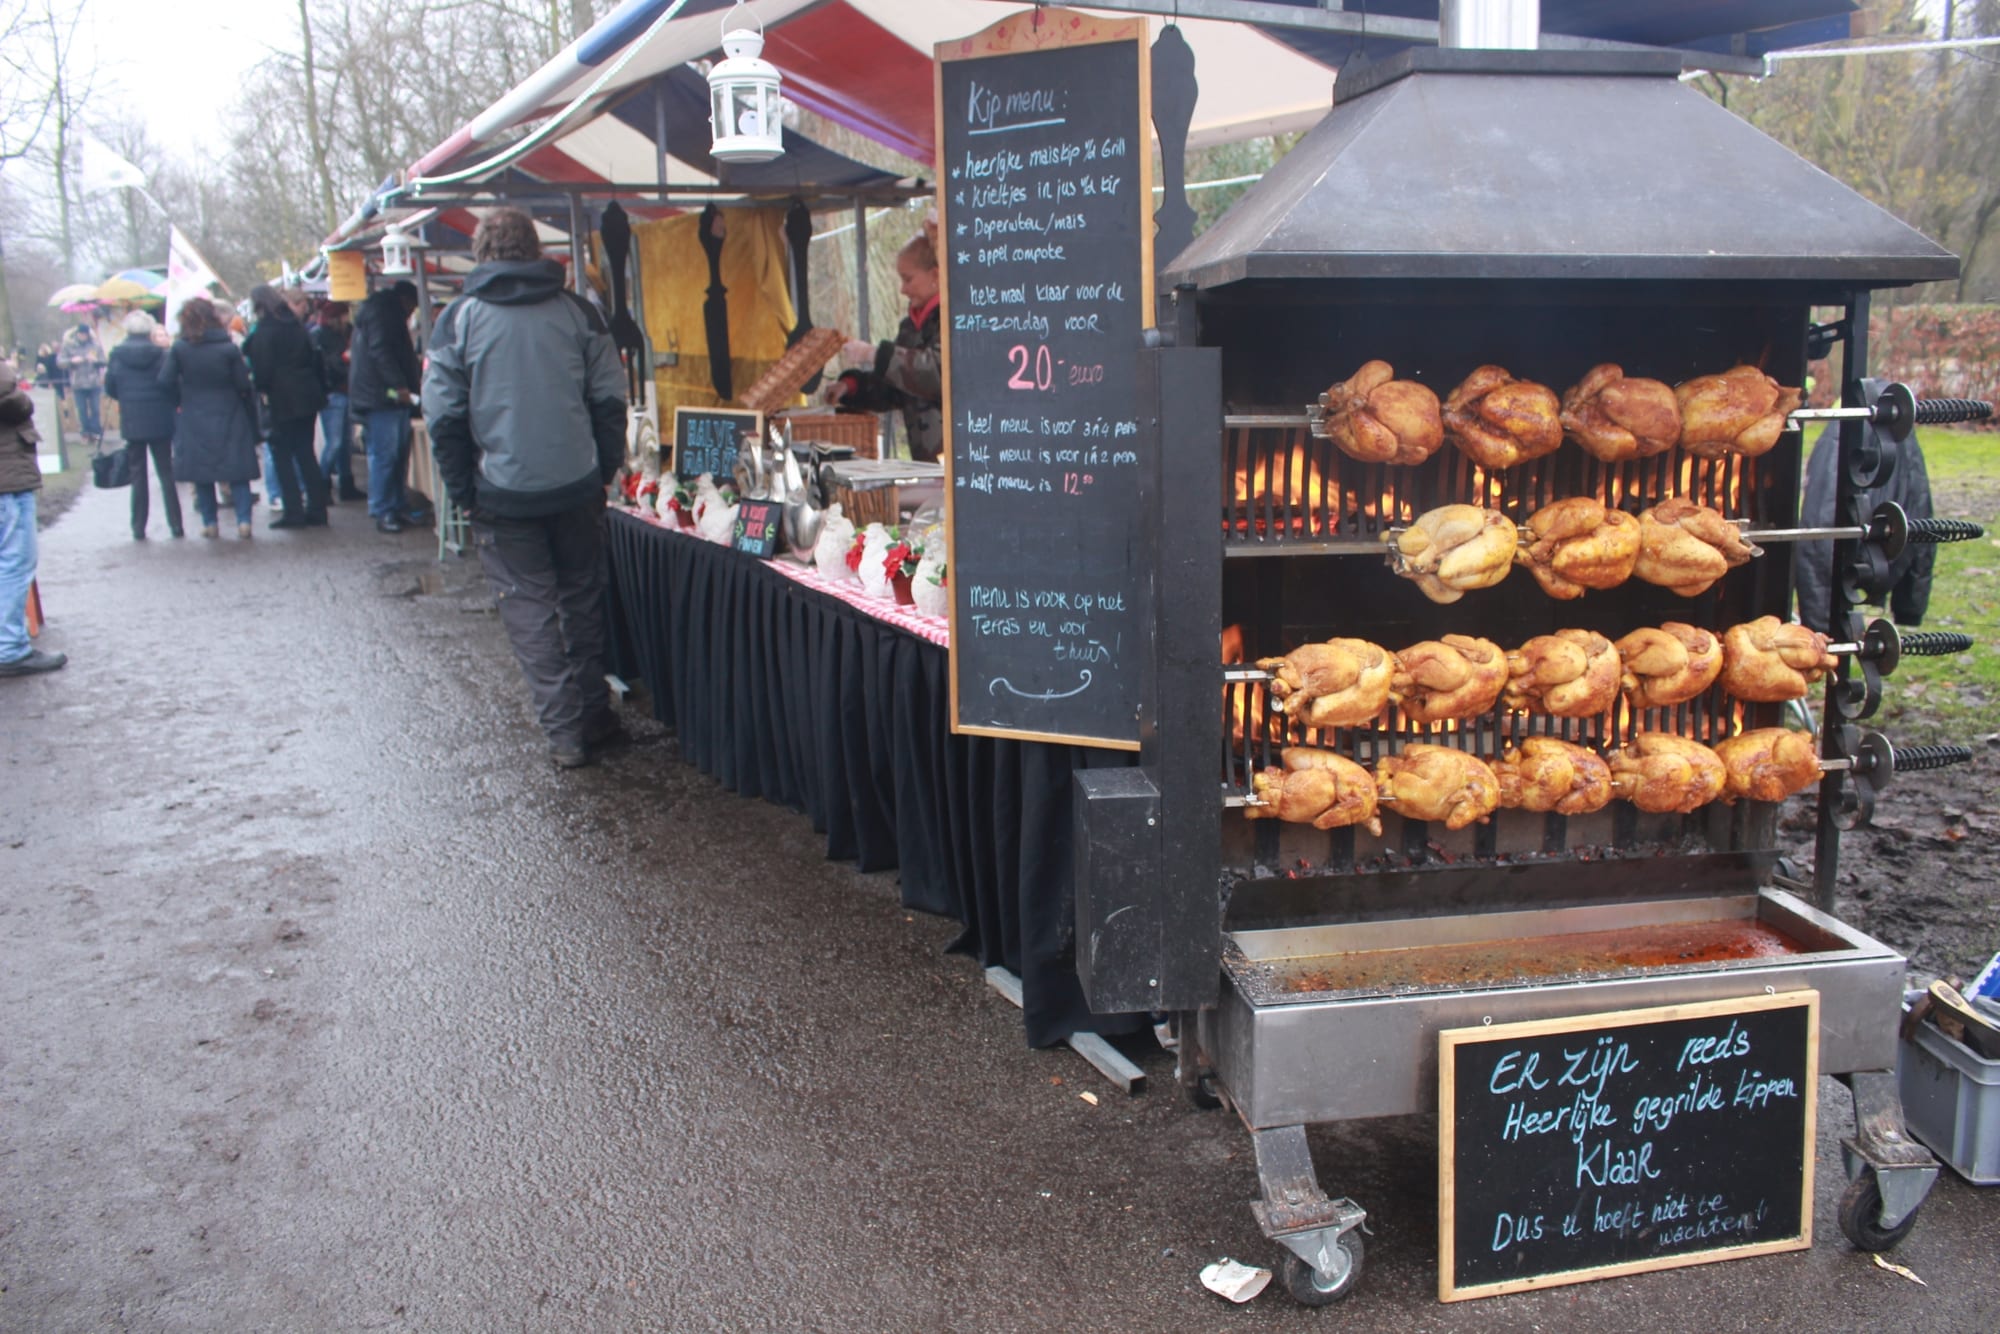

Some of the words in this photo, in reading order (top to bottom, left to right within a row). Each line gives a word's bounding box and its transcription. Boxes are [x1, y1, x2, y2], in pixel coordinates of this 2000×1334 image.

[968, 80, 1000, 128] Kip
[1101, 137, 1126, 158] Grill
[1000, 418, 1034, 435] menu
[1041, 416, 1050, 435] is
[1053, 419, 1076, 436] voor
[969, 441, 991, 471] half
[999, 449, 1032, 463] menu
[1039, 447, 1051, 464] is
[1056, 450, 1080, 464] voor
[970, 471, 995, 495] half
[998, 476, 1035, 492] menu
[1039, 477, 1052, 492] is
[1074, 593, 1093, 616] op
[1097, 590, 1126, 612] het
[971, 613, 1021, 637] Terras
[1028, 619, 1053, 637] en
[1676, 1018, 1751, 1072] reeds
[1633, 1073, 1726, 1134] gegrilde
[1491, 1212, 1545, 1252] Dus
[1562, 1214, 1583, 1237] u
[1593, 1195, 1645, 1239] hoeft
[1651, 1193, 1689, 1223] niet
[1697, 1193, 1729, 1216] te
